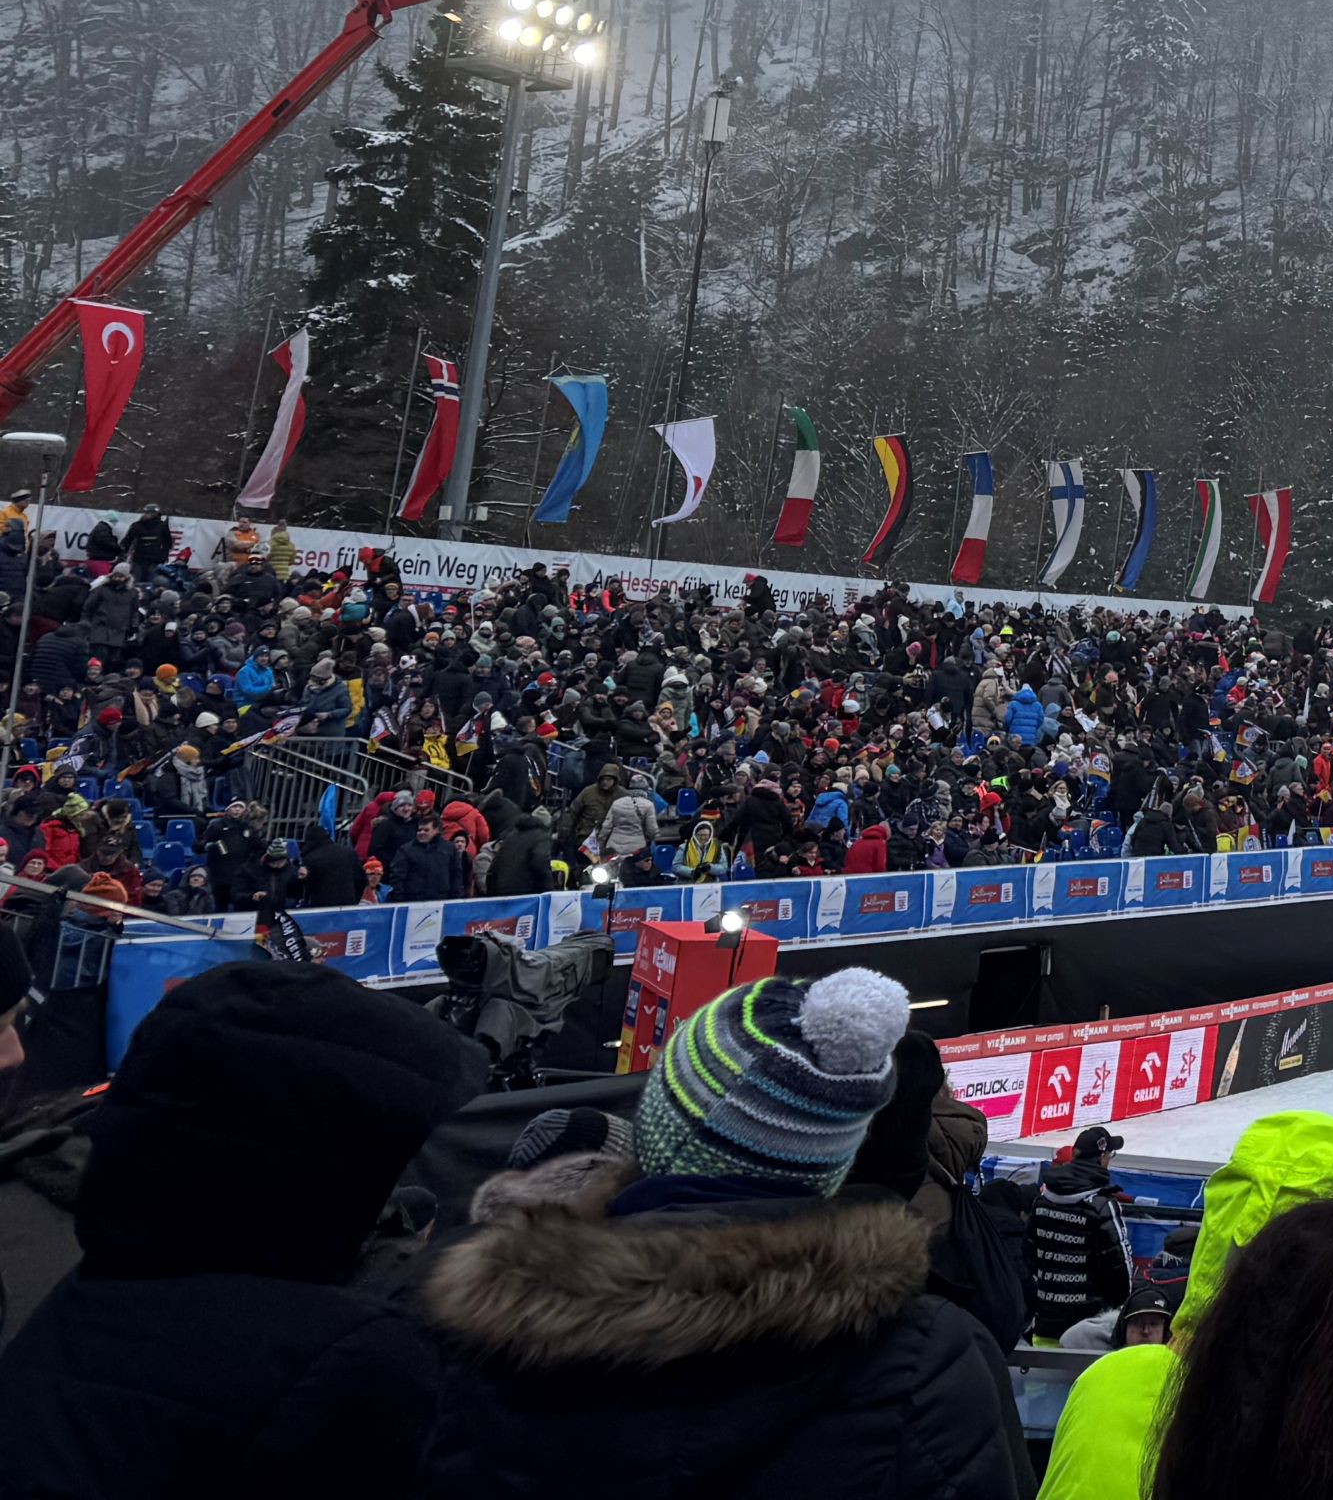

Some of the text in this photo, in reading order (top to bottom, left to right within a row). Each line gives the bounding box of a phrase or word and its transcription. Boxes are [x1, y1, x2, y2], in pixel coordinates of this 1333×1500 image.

[294, 551, 329, 568] sen
[437, 555, 477, 584] Weg
[620, 571, 678, 594] Hessen
[1072, 1024, 1109, 1041] VIESSMANN
[987, 1031, 1064, 1052] VIESSMANN Heat pumps
[952, 1078, 1025, 1099] enDRUCK.de
[1169, 1076, 1188, 1091] star
[1080, 1092, 1101, 1107] star
[1133, 1085, 1161, 1104] ORLEN
[1040, 1103, 1070, 1120] ORLEN
[1054, 1232, 1085, 1244] KINGDOM
[1053, 1253, 1087, 1263] KINGDOM
[1053, 1273, 1087, 1282] KINGDOM
[1053, 1293, 1087, 1303] KINGDOM
